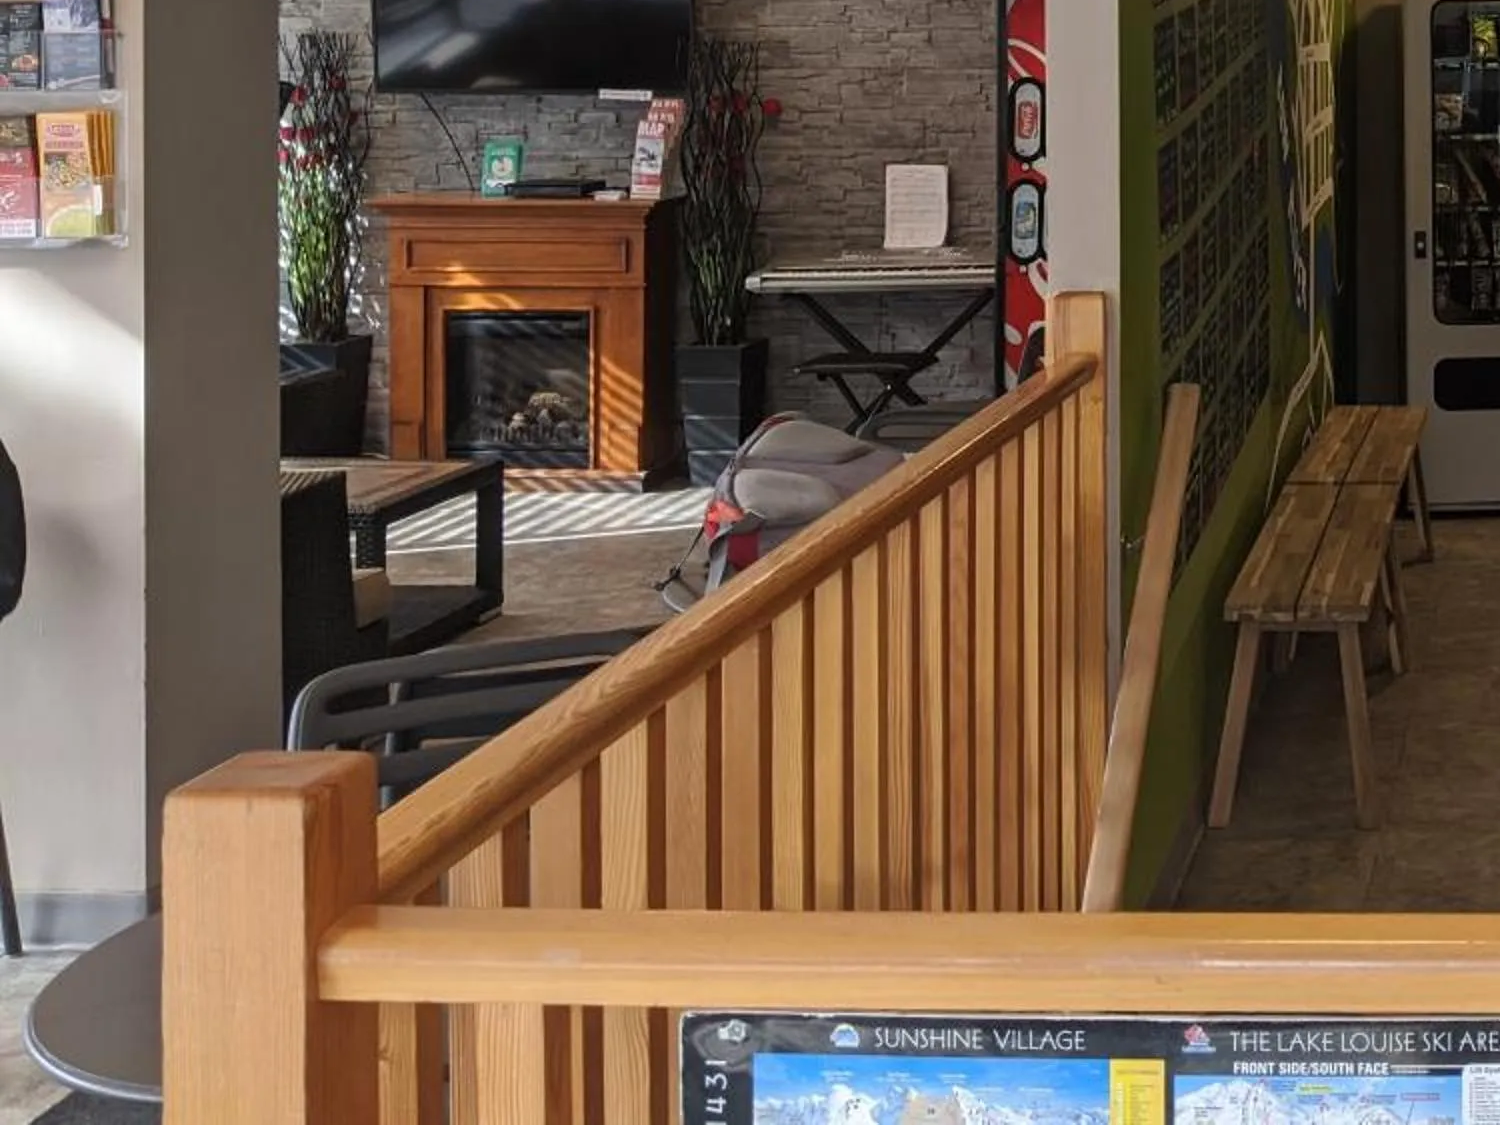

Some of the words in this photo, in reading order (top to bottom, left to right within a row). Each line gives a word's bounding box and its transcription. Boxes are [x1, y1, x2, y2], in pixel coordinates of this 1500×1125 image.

[637, 120, 665, 136] MAP
[874, 1027, 983, 1051] SUNSHINE
[993, 1029, 1086, 1052] VILLAGE
[1229, 1030, 1270, 1053] THE
[1277, 1030, 1335, 1053] LAKE
[1340, 1030, 1417, 1053] LOUISE
[1422, 1030, 1452, 1053] SKI
[1233, 1062, 1274, 1075] FRONT
[1277, 1062, 1354, 1075] SIDE/SOUTH
[1357, 1062, 1389, 1075] FACE
